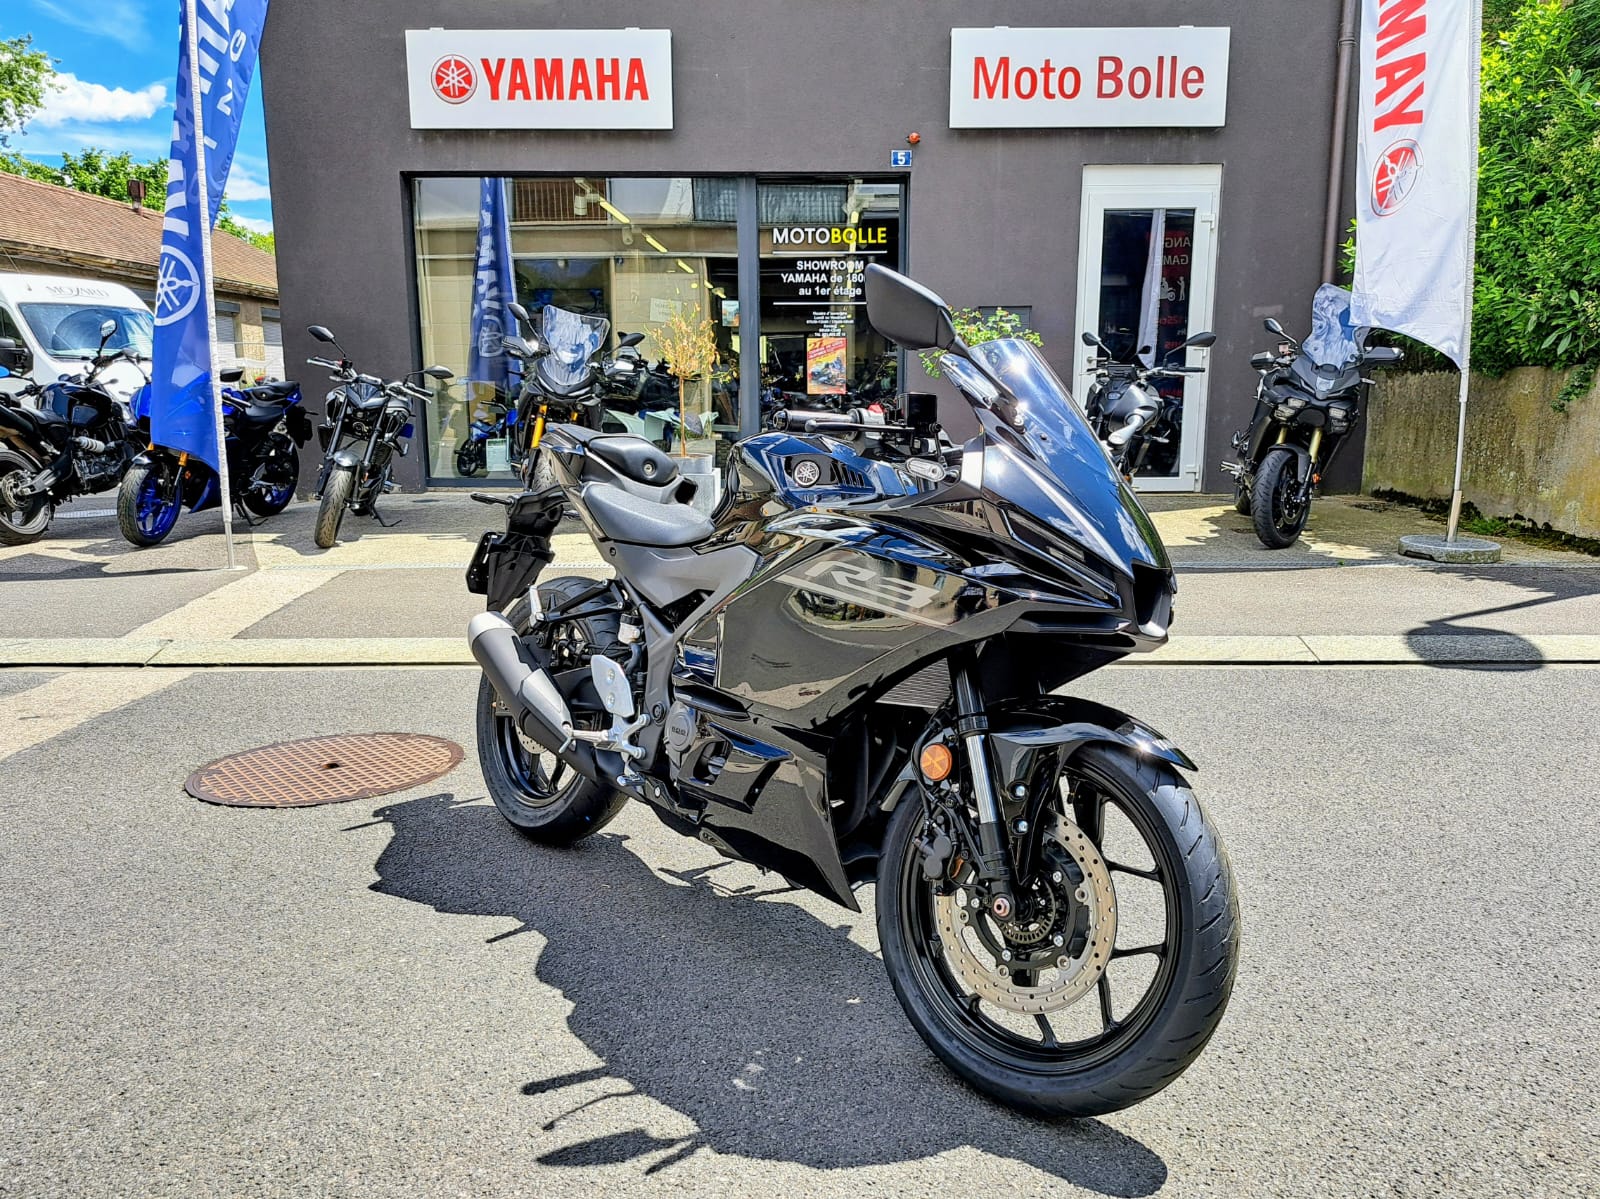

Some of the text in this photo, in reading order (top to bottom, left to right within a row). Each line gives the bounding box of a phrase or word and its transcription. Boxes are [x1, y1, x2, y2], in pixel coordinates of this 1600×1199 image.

[480, 58, 649, 100] YAMAHA
[972, 56, 1205, 100] Moto Bolle
[897, 152, 906, 165] 5
[772, 227, 887, 244] MOTOBOLLE
[796, 260, 864, 271] SHOWROOM
[781, 273, 866, 283] YAMAHA de 180
[799, 285, 862, 298] au 1er étage
[804, 560, 940, 609] R3
